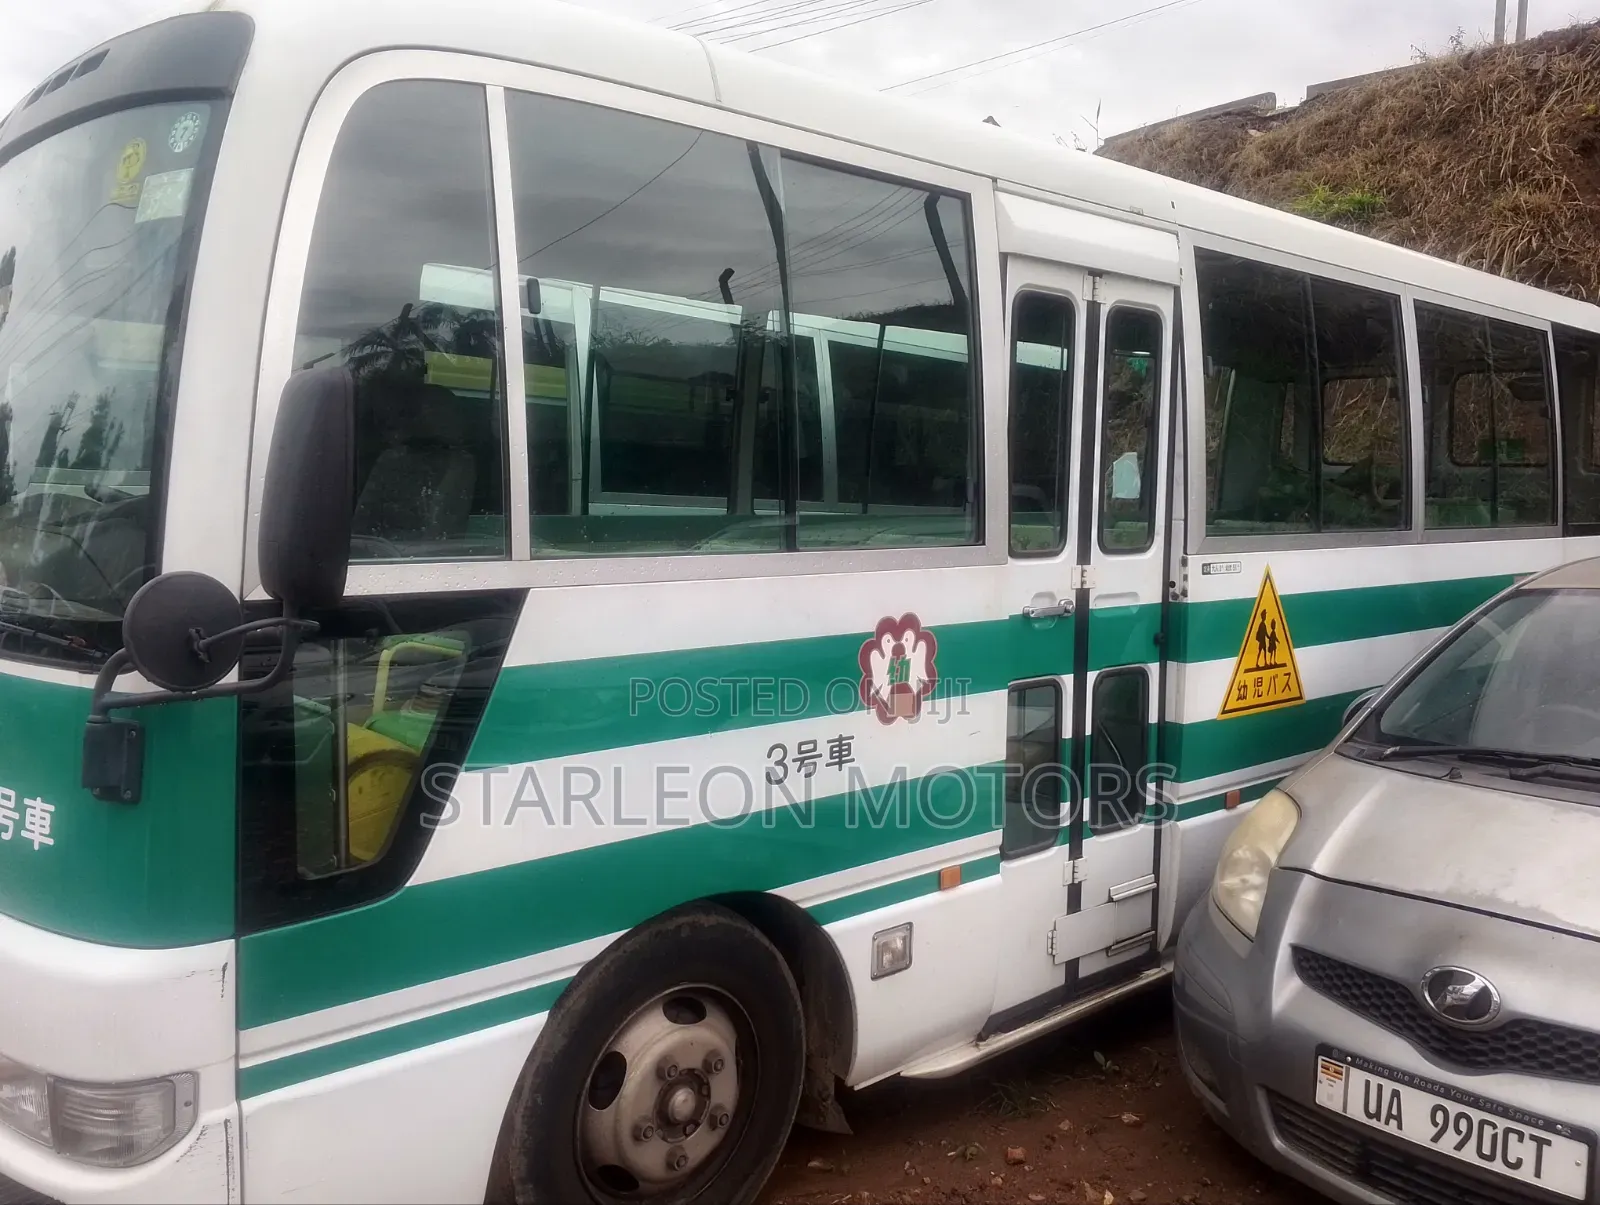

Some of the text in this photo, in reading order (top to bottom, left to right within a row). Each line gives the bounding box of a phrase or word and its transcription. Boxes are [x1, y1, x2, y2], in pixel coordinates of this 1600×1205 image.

[1236, 673, 1291, 701] 幼児バス
[765, 733, 856, 786] 3号車
[1355, 1057, 1545, 1127] Making the Roads Your Safe Space
[1363, 1078, 1552, 1179] UA 990CT
